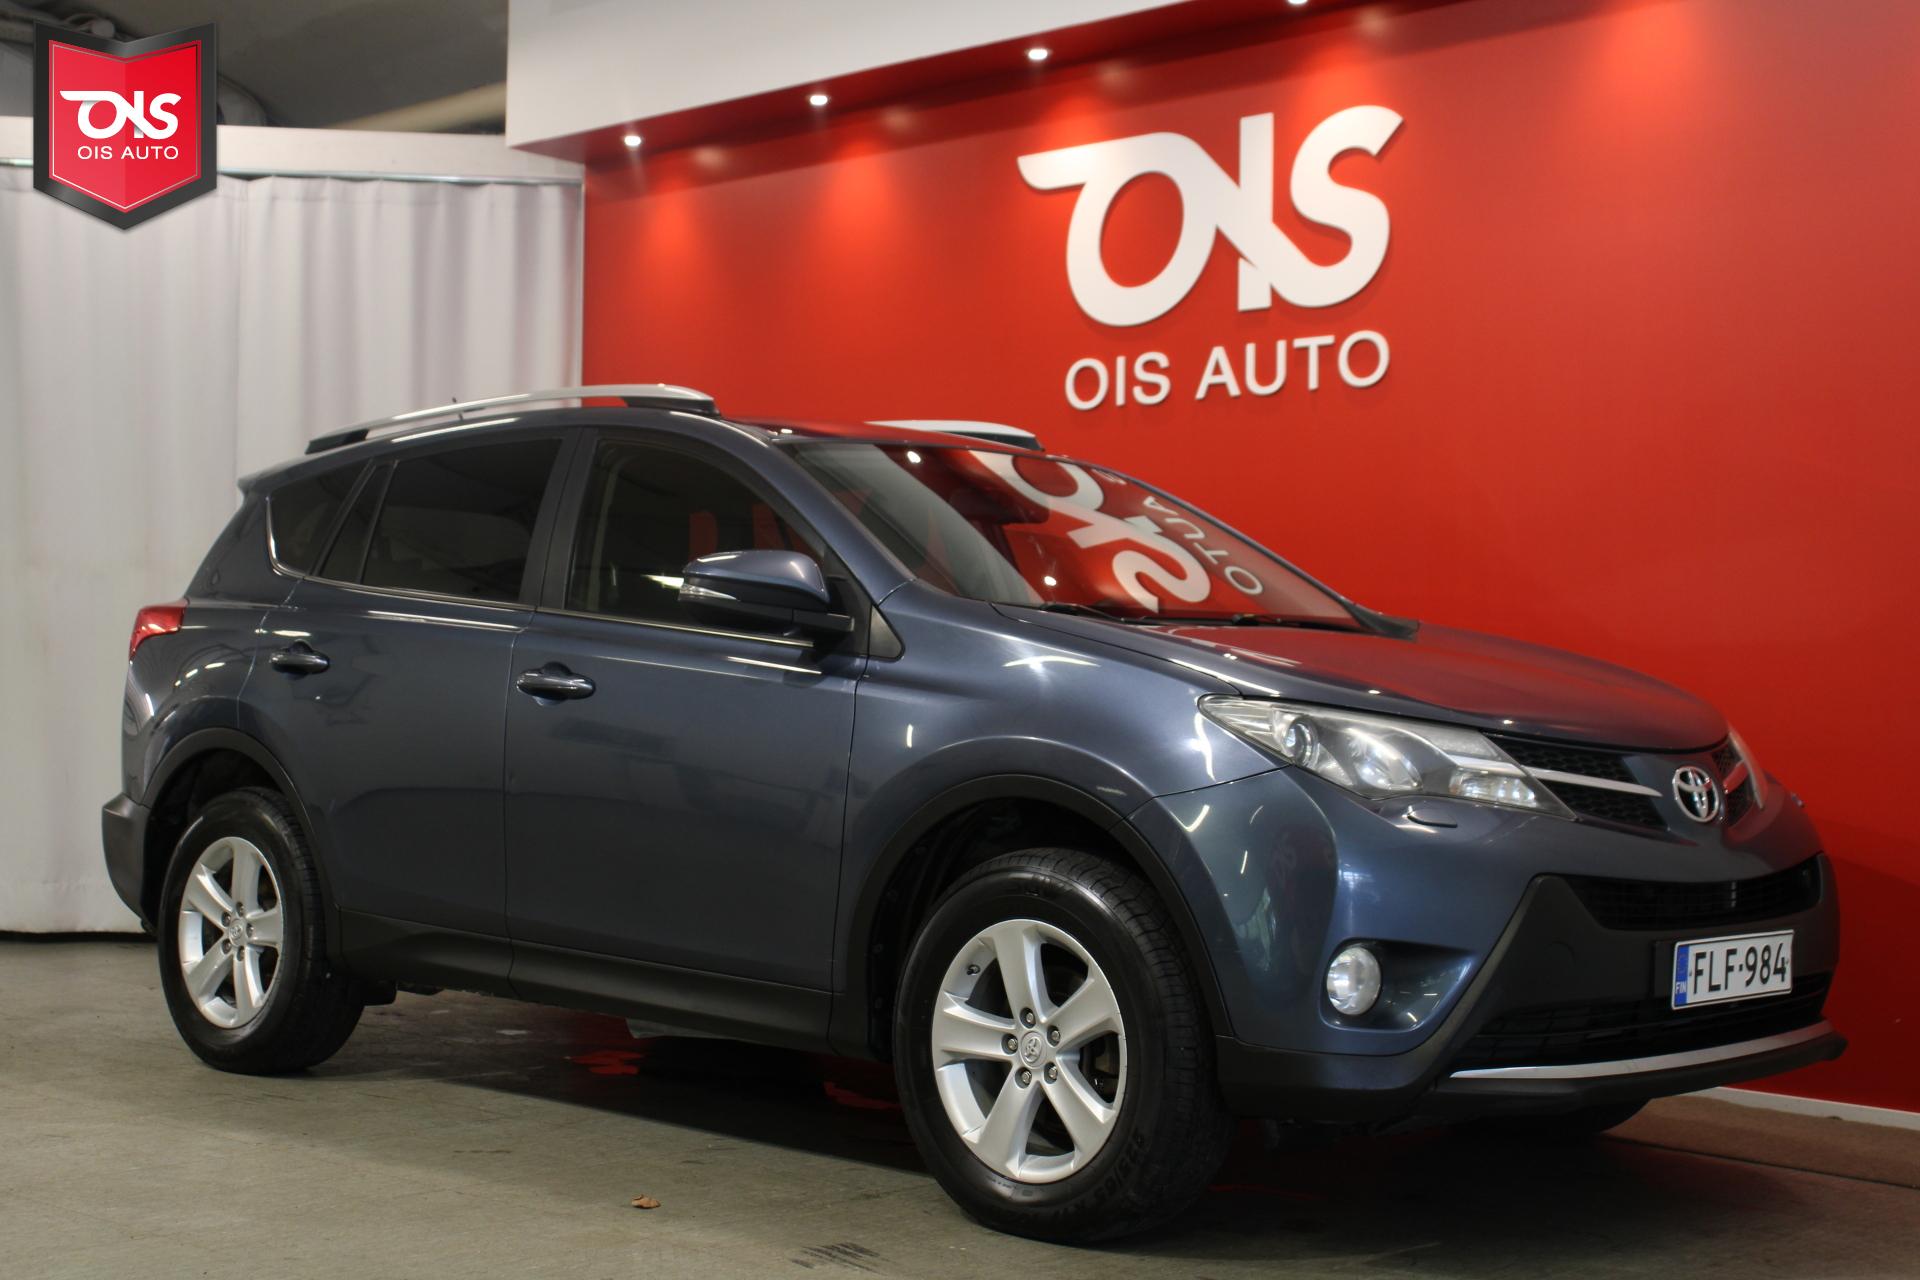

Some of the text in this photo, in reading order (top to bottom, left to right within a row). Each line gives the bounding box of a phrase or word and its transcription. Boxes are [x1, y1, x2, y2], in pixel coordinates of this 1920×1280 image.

[1064, 330, 1390, 411] OIS AUTO
[1675, 981, 1687, 995] FIN
[1693, 942, 1787, 995] FLF-984
